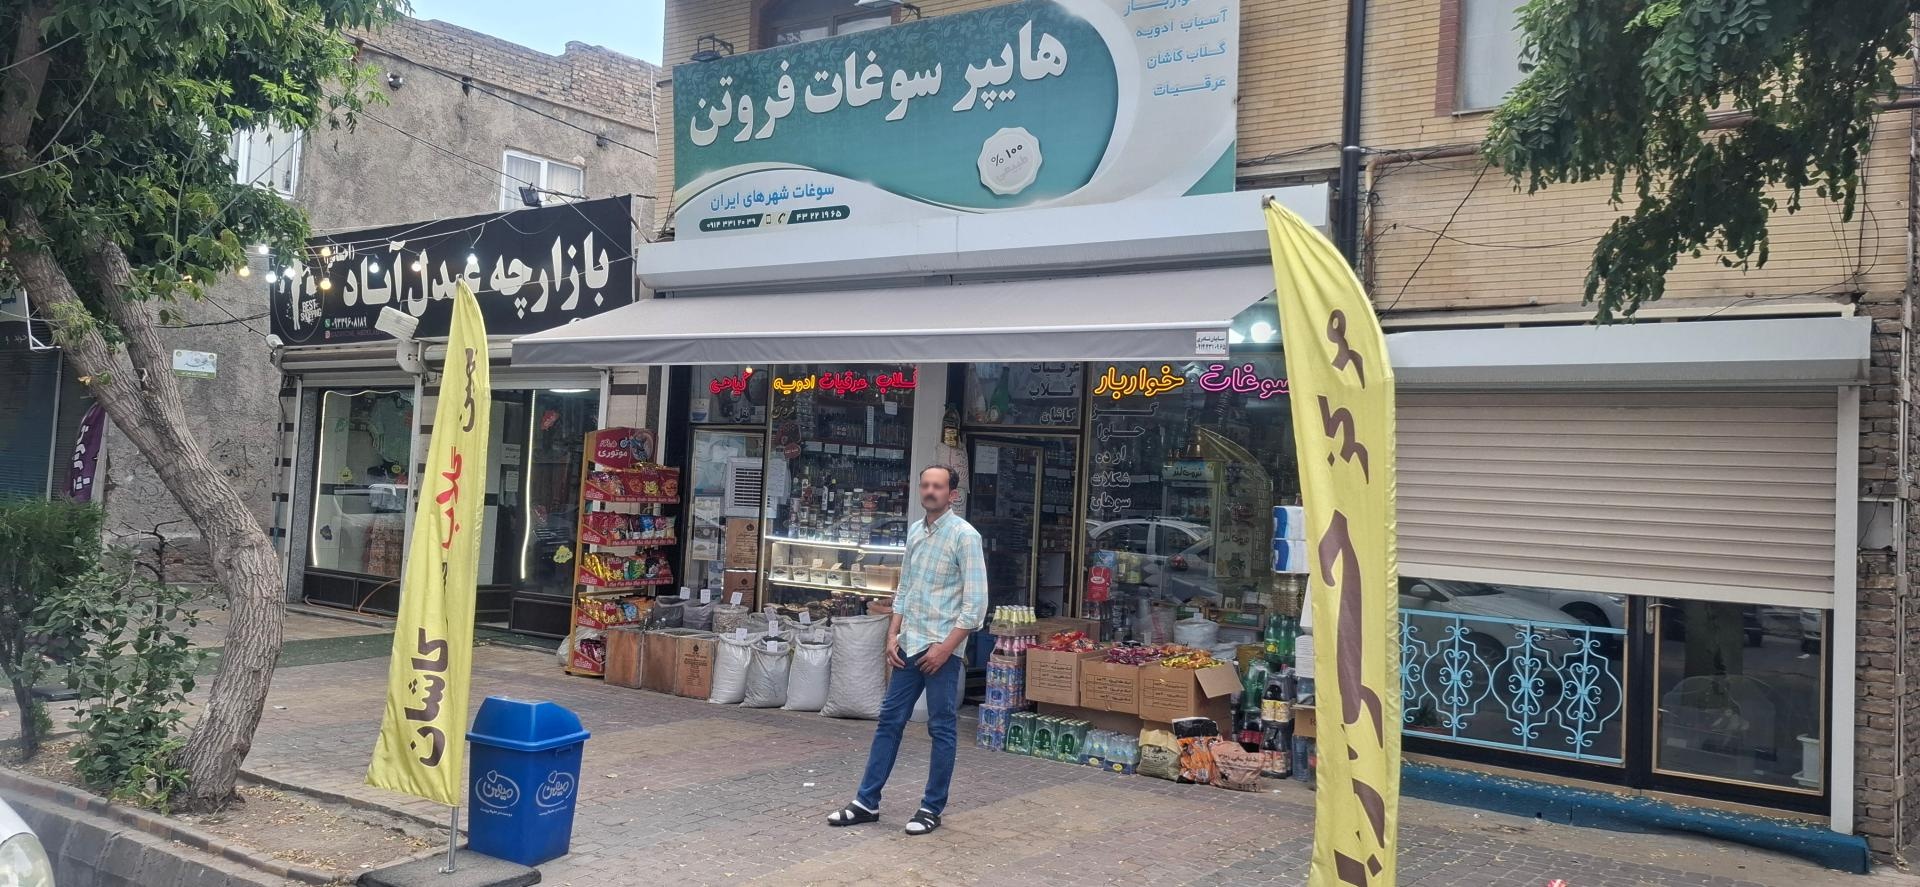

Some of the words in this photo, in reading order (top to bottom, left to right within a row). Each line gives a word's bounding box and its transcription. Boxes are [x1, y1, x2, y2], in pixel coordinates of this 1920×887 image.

[1136, 21, 1174, 38] ادویه
[1180, 9, 1228, 32] آسیاب
[1146, 50, 1183, 69] کاشان
[1186, 42, 1226, 62] گلاب
[952, 20, 1068, 112] هایپر
[804, 50, 943, 121] سوغات
[1153, 76, 1226, 97] عرقیات
[690, 60, 796, 146] فروتن
[1005, 144, 1023, 159] ۱۰۰
[711, 192, 739, 211] ایران
[793, 184, 834, 200] سوغات
[490, 232, 609, 319] بازارچه
[773, 374, 816, 394] ادویه
[818, 370, 868, 395] عرقیات
[1094, 365, 1185, 400] خواربار
[1040, 407, 1076, 424] کاشان
[1096, 422, 1145, 441] حلوا
[1095, 445, 1126, 464] ارده
[1091, 470, 1131, 487] شکلات
[435, 446, 463, 551] گلاب
[1090, 491, 1131, 513] سوهان
[404, 627, 449, 769] کاشان
[483, 781, 513, 800] میهن
[542, 781, 569, 800] میهن
